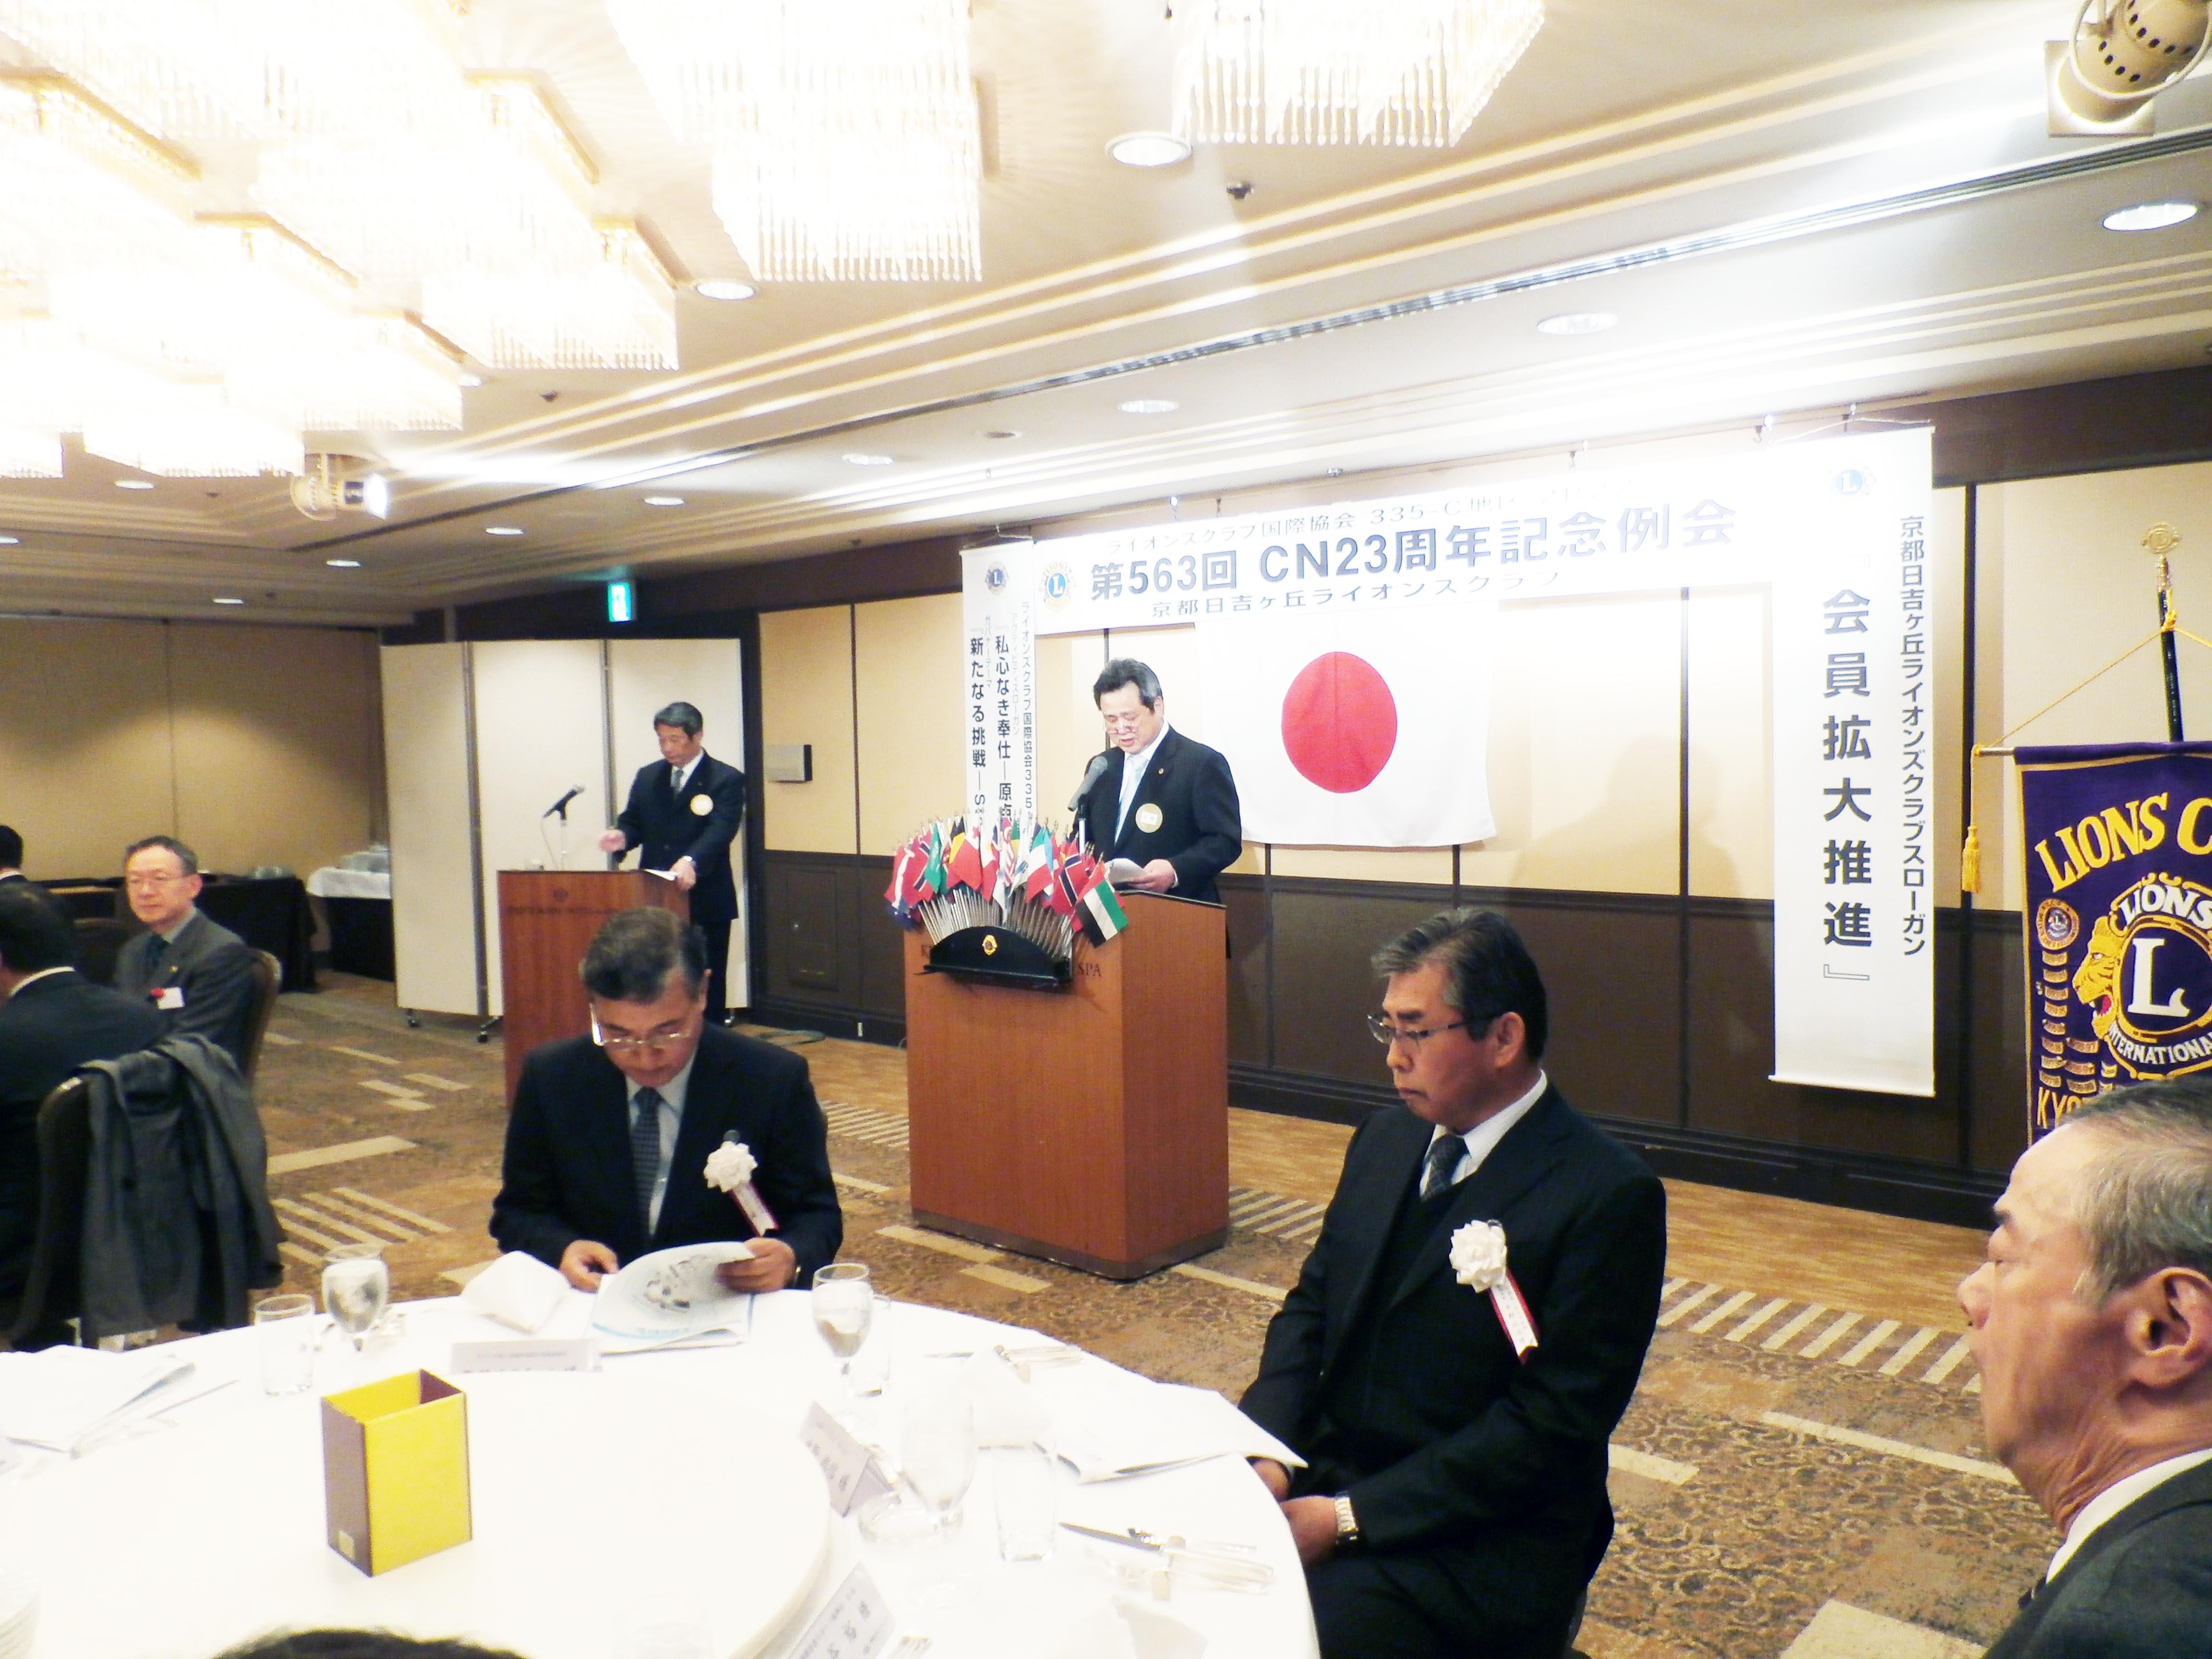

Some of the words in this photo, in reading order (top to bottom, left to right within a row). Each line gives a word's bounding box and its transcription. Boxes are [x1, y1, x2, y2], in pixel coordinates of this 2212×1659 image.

[1091, 550, 1237, 601] 第563回
[1260, 499, 1737, 582] CN23周年記念例会
[2035, 792, 2168, 893] LIONS
[2119, 884, 2212, 930] LIONS
[2128, 938, 2191, 1018] L
[2109, 1020, 2212, 1065] INTERNATIONA
